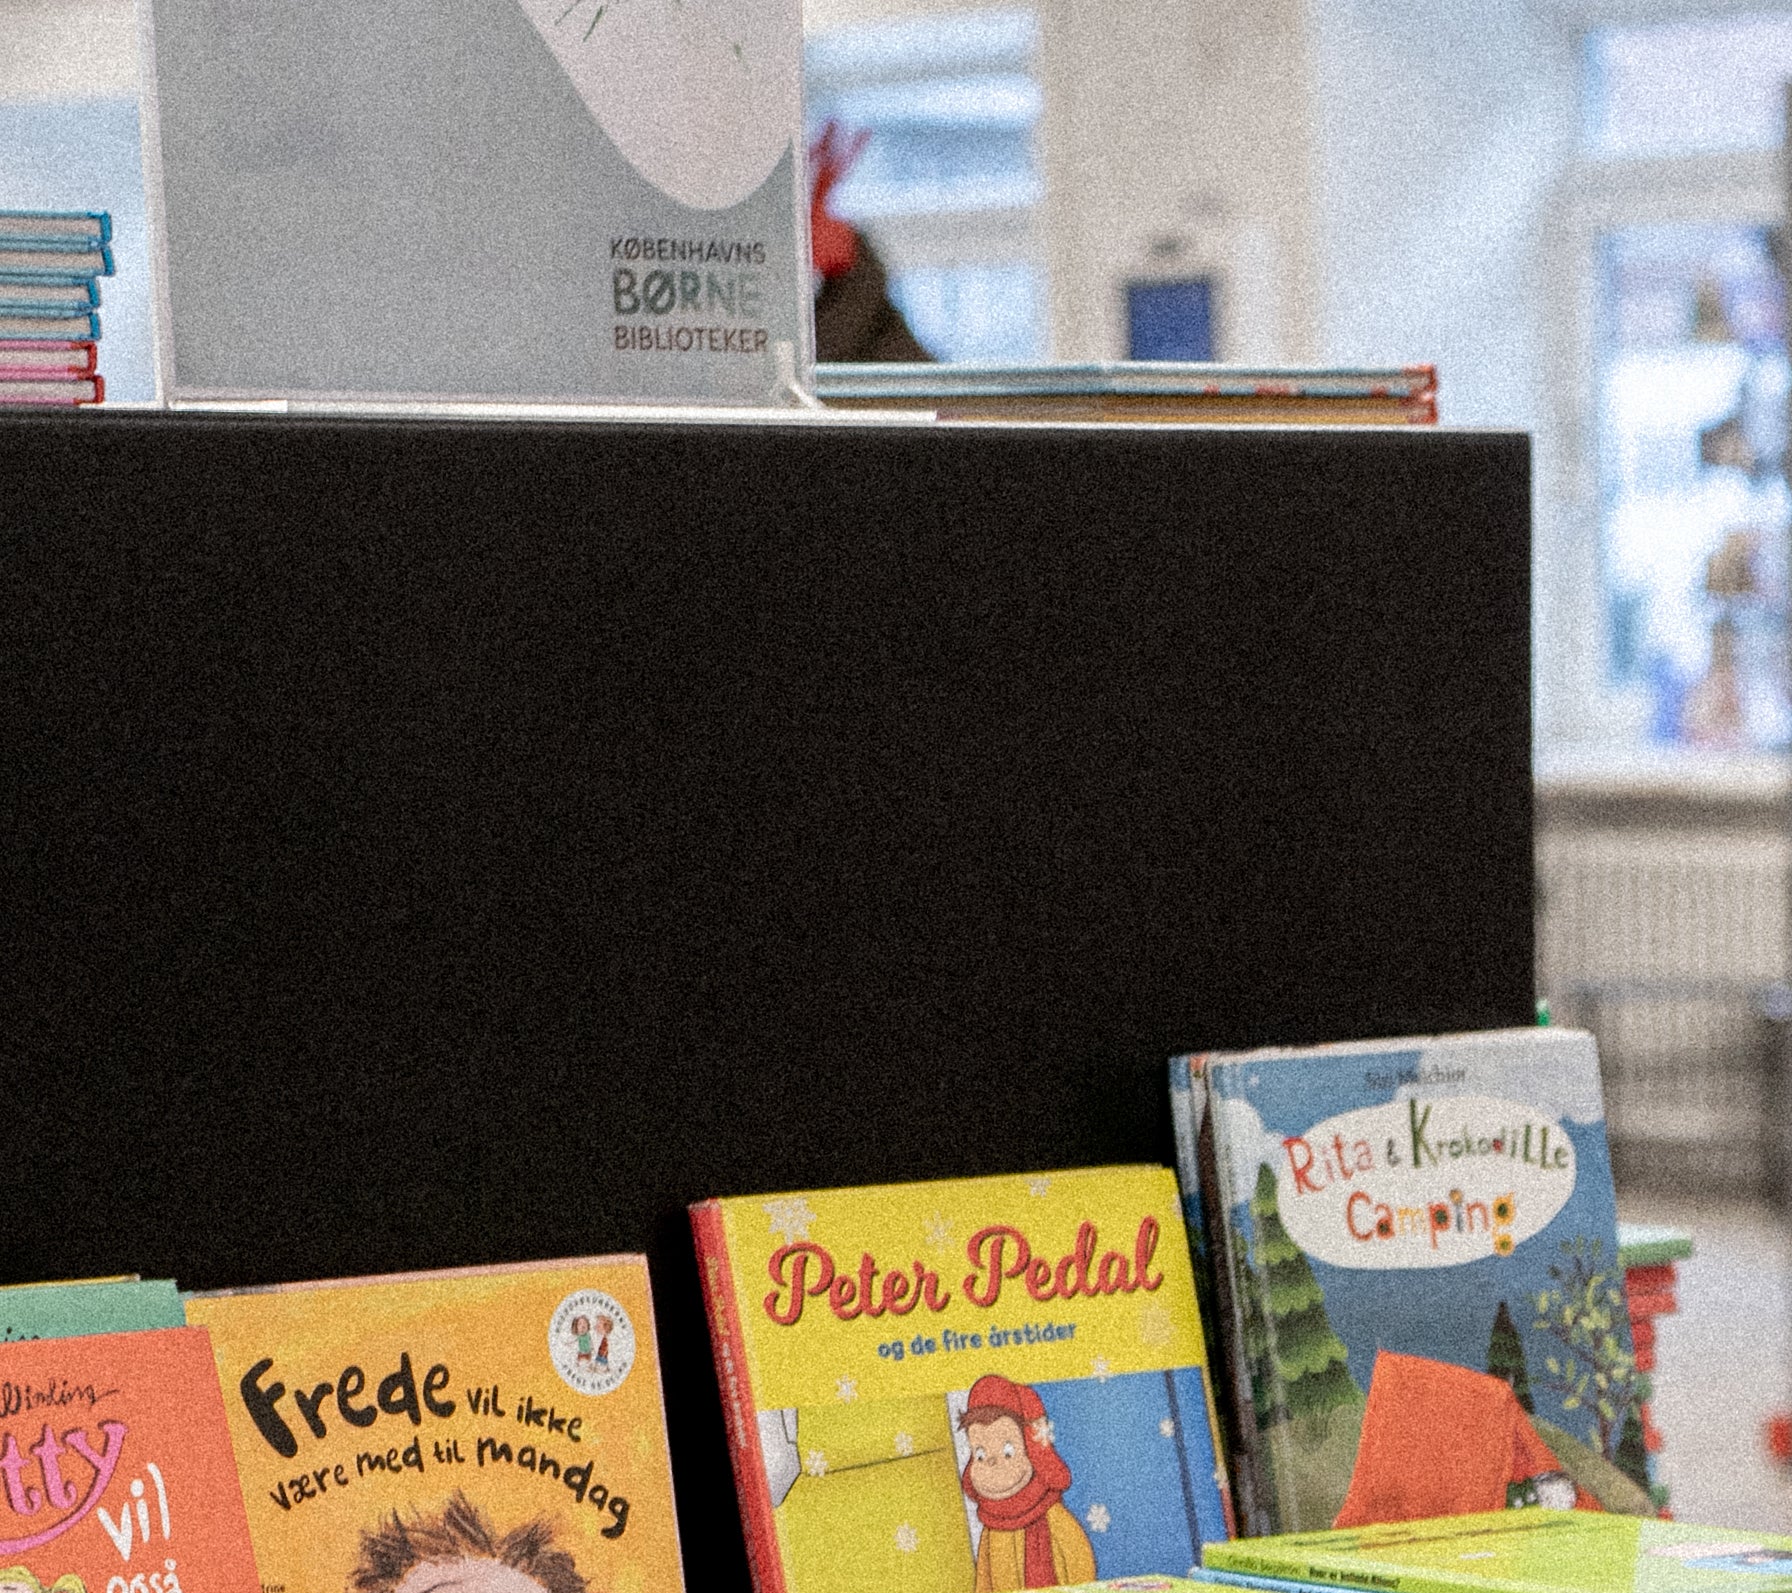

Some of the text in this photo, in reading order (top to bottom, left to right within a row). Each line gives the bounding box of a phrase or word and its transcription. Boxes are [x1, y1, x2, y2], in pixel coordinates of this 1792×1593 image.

[610, 237, 767, 264] KØBENHAVNS
[613, 268, 762, 318] BØRNE
[613, 325, 768, 353] BIBLIOTEKER
[1281, 1133, 1376, 1196] Rita
[1345, 1188, 1518, 1257] Camping
[763, 1215, 1164, 1326] Peter Pedal
[878, 1322, 1078, 1361] og de fire årstider
[240, 1350, 584, 1459] Frede vil ikke
[97, 1462, 171, 1562] vil
[268, 1435, 633, 1540] være med til mandag
